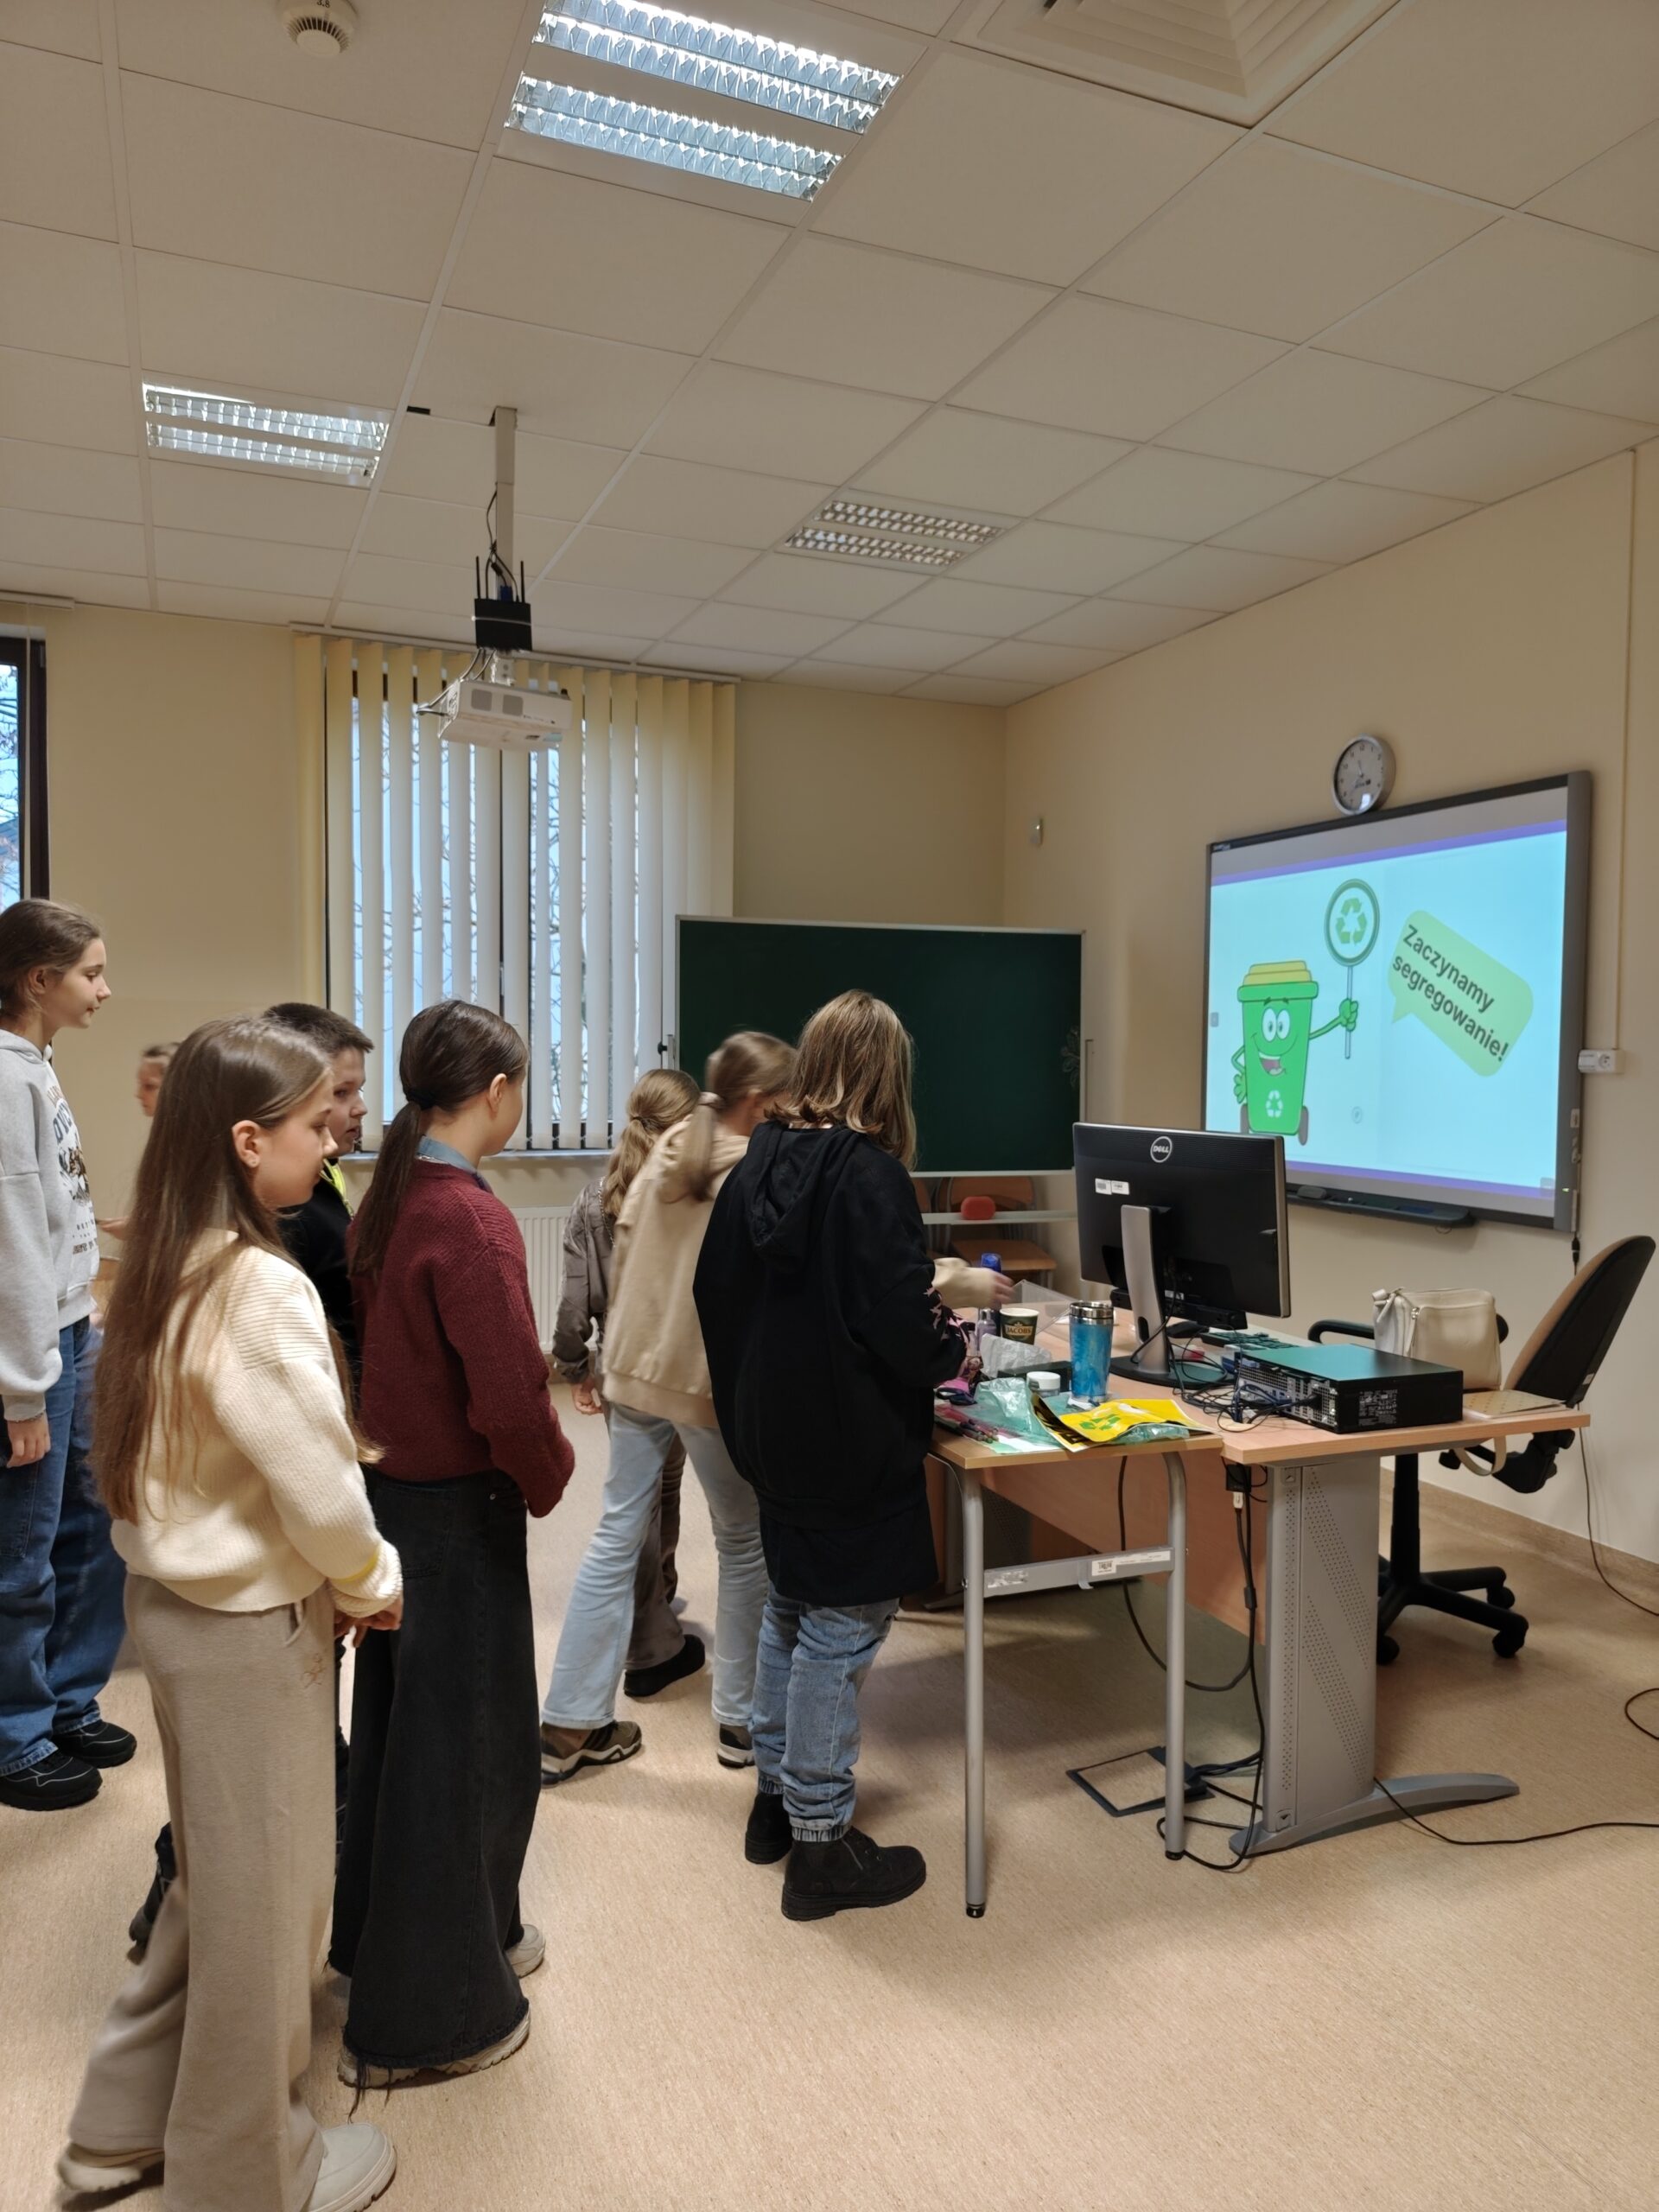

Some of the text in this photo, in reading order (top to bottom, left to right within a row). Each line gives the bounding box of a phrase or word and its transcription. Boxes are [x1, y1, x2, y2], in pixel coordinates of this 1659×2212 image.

[1392, 955, 1510, 1062] segregowanie!
[1402, 924, 1495, 1014] Zaczynamy
[1007, 1325, 1031, 1335] JACOBS
